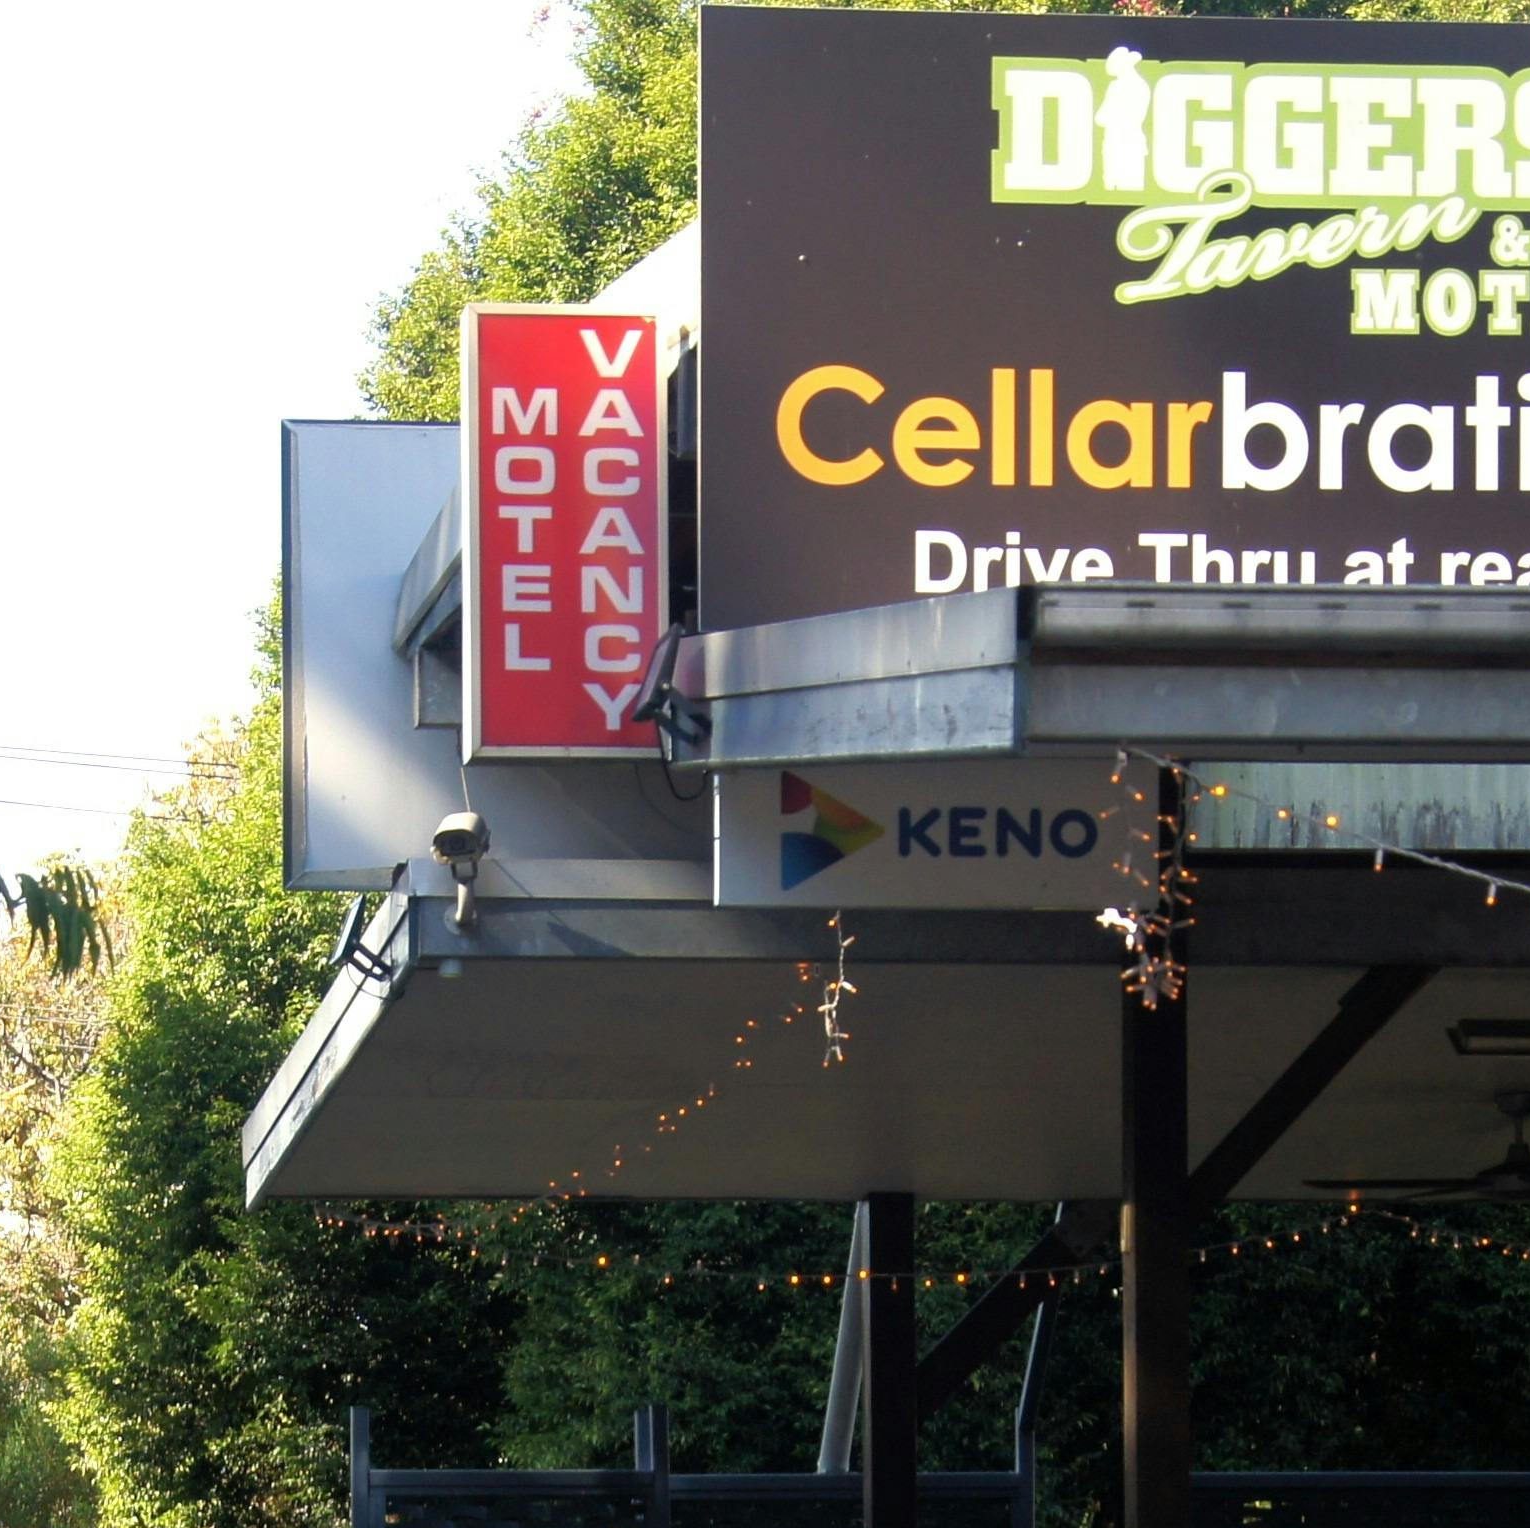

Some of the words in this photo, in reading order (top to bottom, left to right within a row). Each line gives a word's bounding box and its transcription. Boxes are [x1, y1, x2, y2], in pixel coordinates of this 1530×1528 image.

[1115, 168, 1481, 304] Tavern
[490, 386, 560, 672] MOTEL
[577, 328, 646, 732] VACANCY
[897, 805, 1098, 859] KENO
